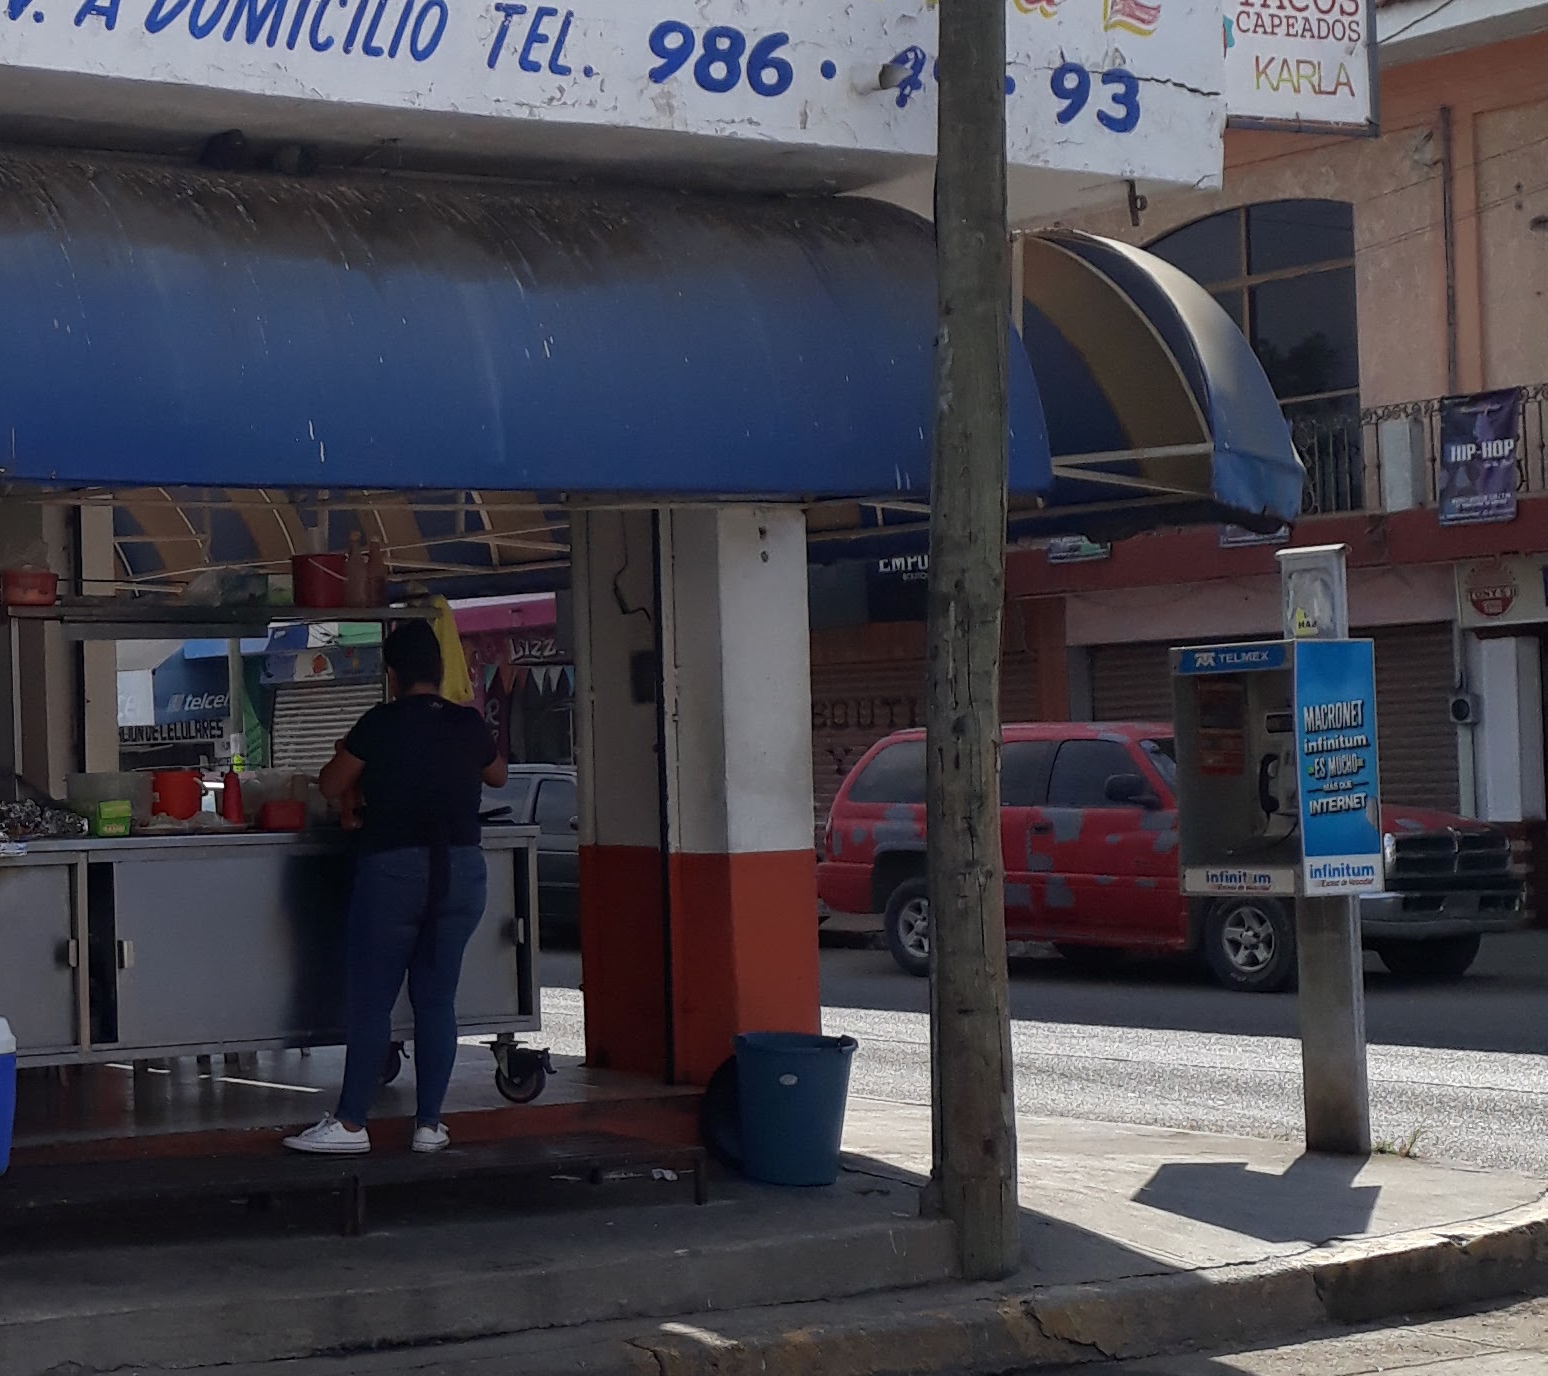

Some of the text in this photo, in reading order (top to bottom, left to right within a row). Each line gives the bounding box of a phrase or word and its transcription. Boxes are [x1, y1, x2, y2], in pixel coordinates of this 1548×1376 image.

[486, 3, 596, 77] TEL.
[1235, 12, 1362, 44] CAPEADOS
[1254, 54, 1355, 97] KARLA
[1217, 650, 1269, 663] TELMEX
[1303, 699, 1363, 732] MACRONET
[1303, 734, 1368, 754] infinitum
[1328, 753, 1358, 778] MUCHO
[1309, 792, 1367, 815] INTERNET
[1309, 862, 1375, 879] infinitum
